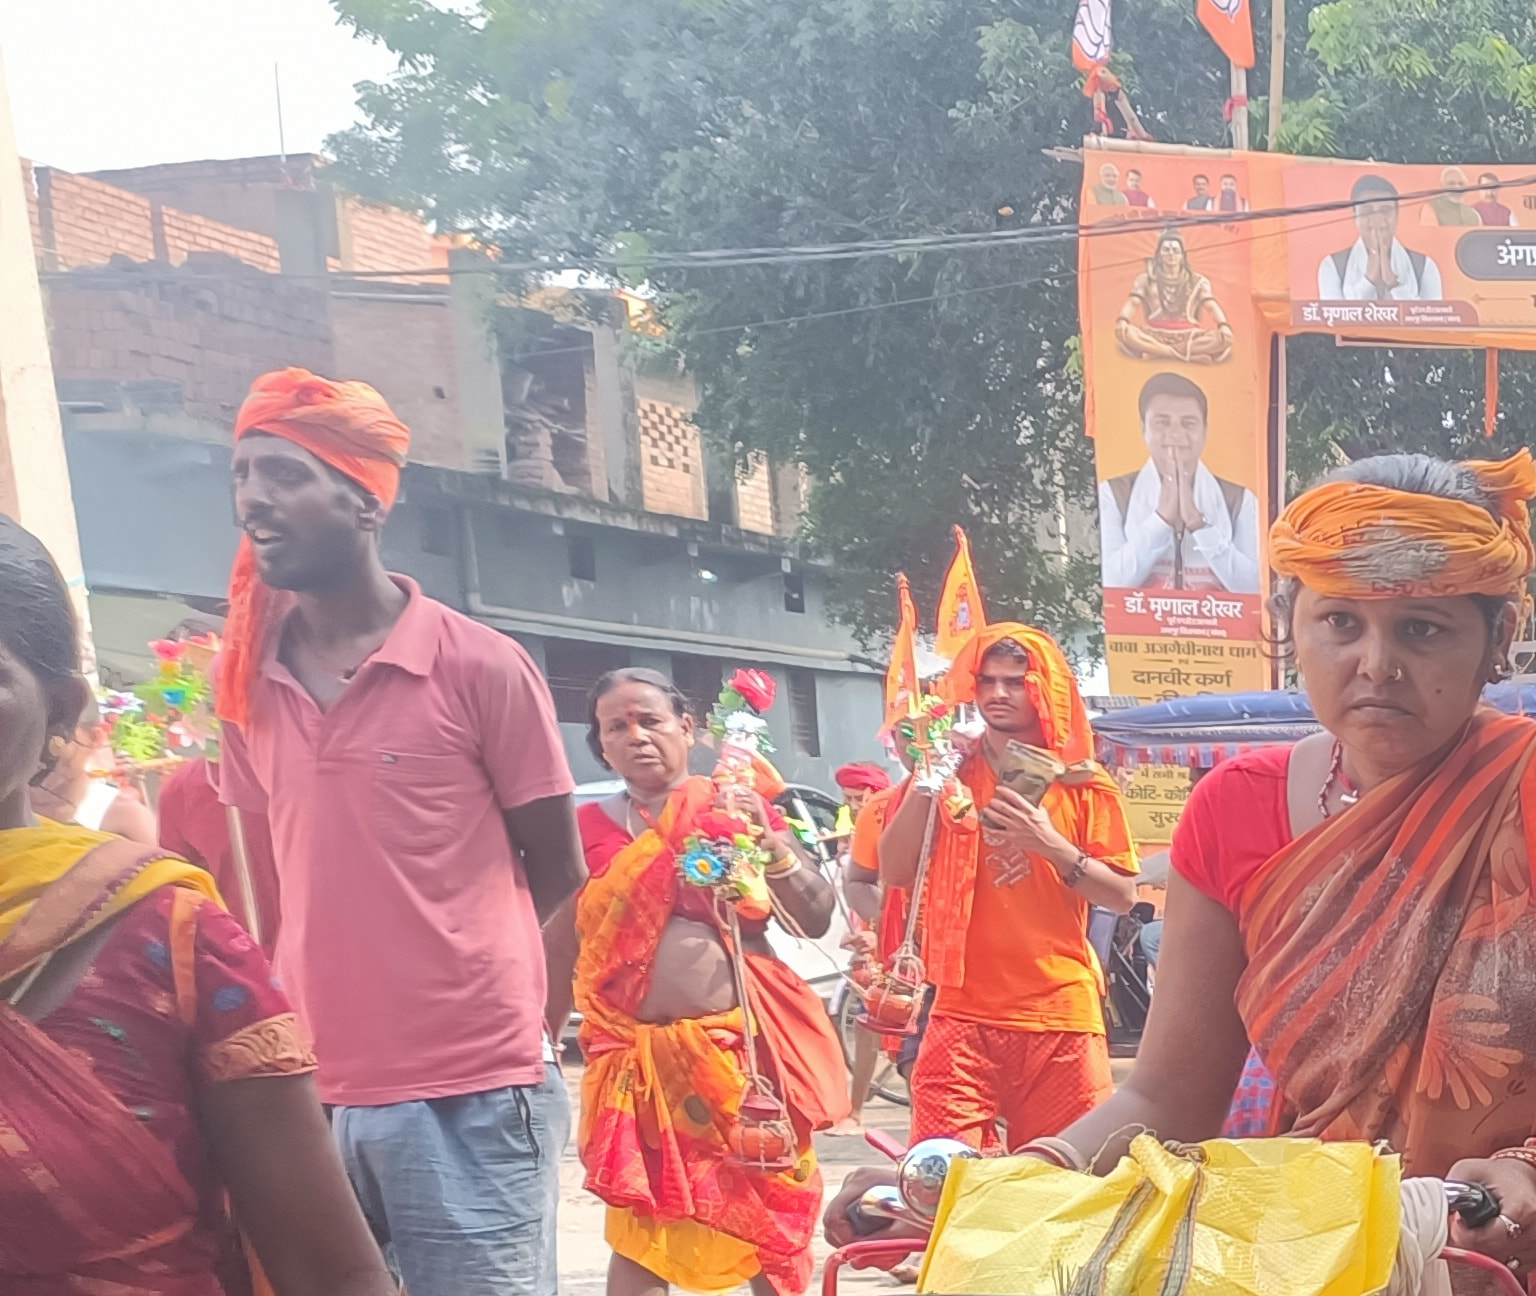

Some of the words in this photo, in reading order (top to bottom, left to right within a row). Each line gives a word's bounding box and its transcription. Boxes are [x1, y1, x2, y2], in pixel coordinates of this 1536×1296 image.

[1302, 302, 1321, 322] डॉ.
[1322, 305, 1363, 326] मृणाल
[1364, 302, 1398, 322] शेखर
[1123, 591, 1147, 614] डॉ.
[1148, 596, 1200, 621] मृणाल
[1201, 594, 1243, 619] शेखर
[1132, 667, 1194, 687] दानवीर
[1194, 669, 1233, 688] कर्ण
[1125, 784, 1162, 800] कोटि-
